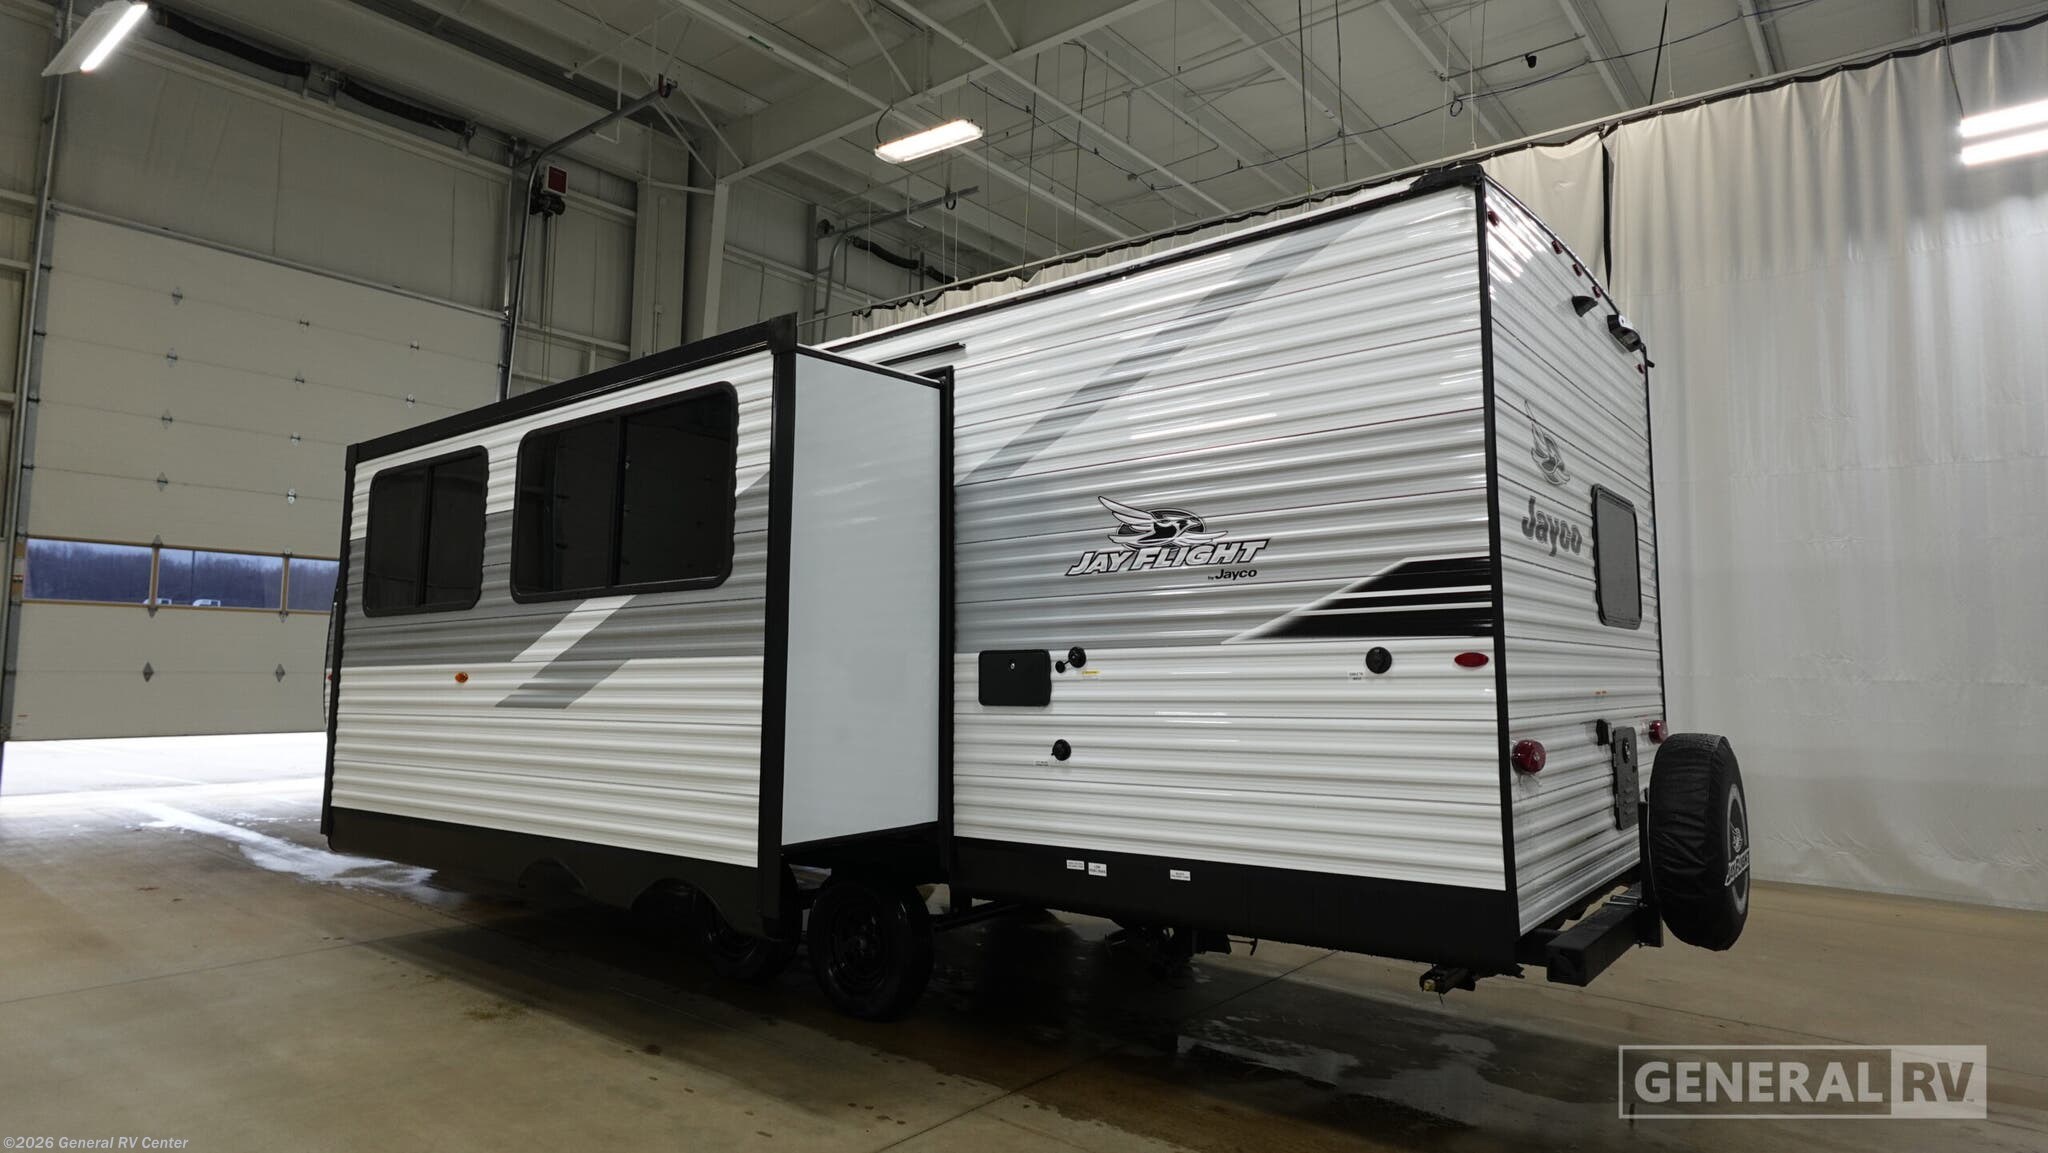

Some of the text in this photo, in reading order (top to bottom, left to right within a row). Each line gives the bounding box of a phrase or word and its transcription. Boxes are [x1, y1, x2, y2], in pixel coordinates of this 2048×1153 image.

[1521, 495, 1582, 557] Jayco
[1065, 539, 1271, 576] JAY FLIGHT
[1215, 569, 1257, 580] Jayco
